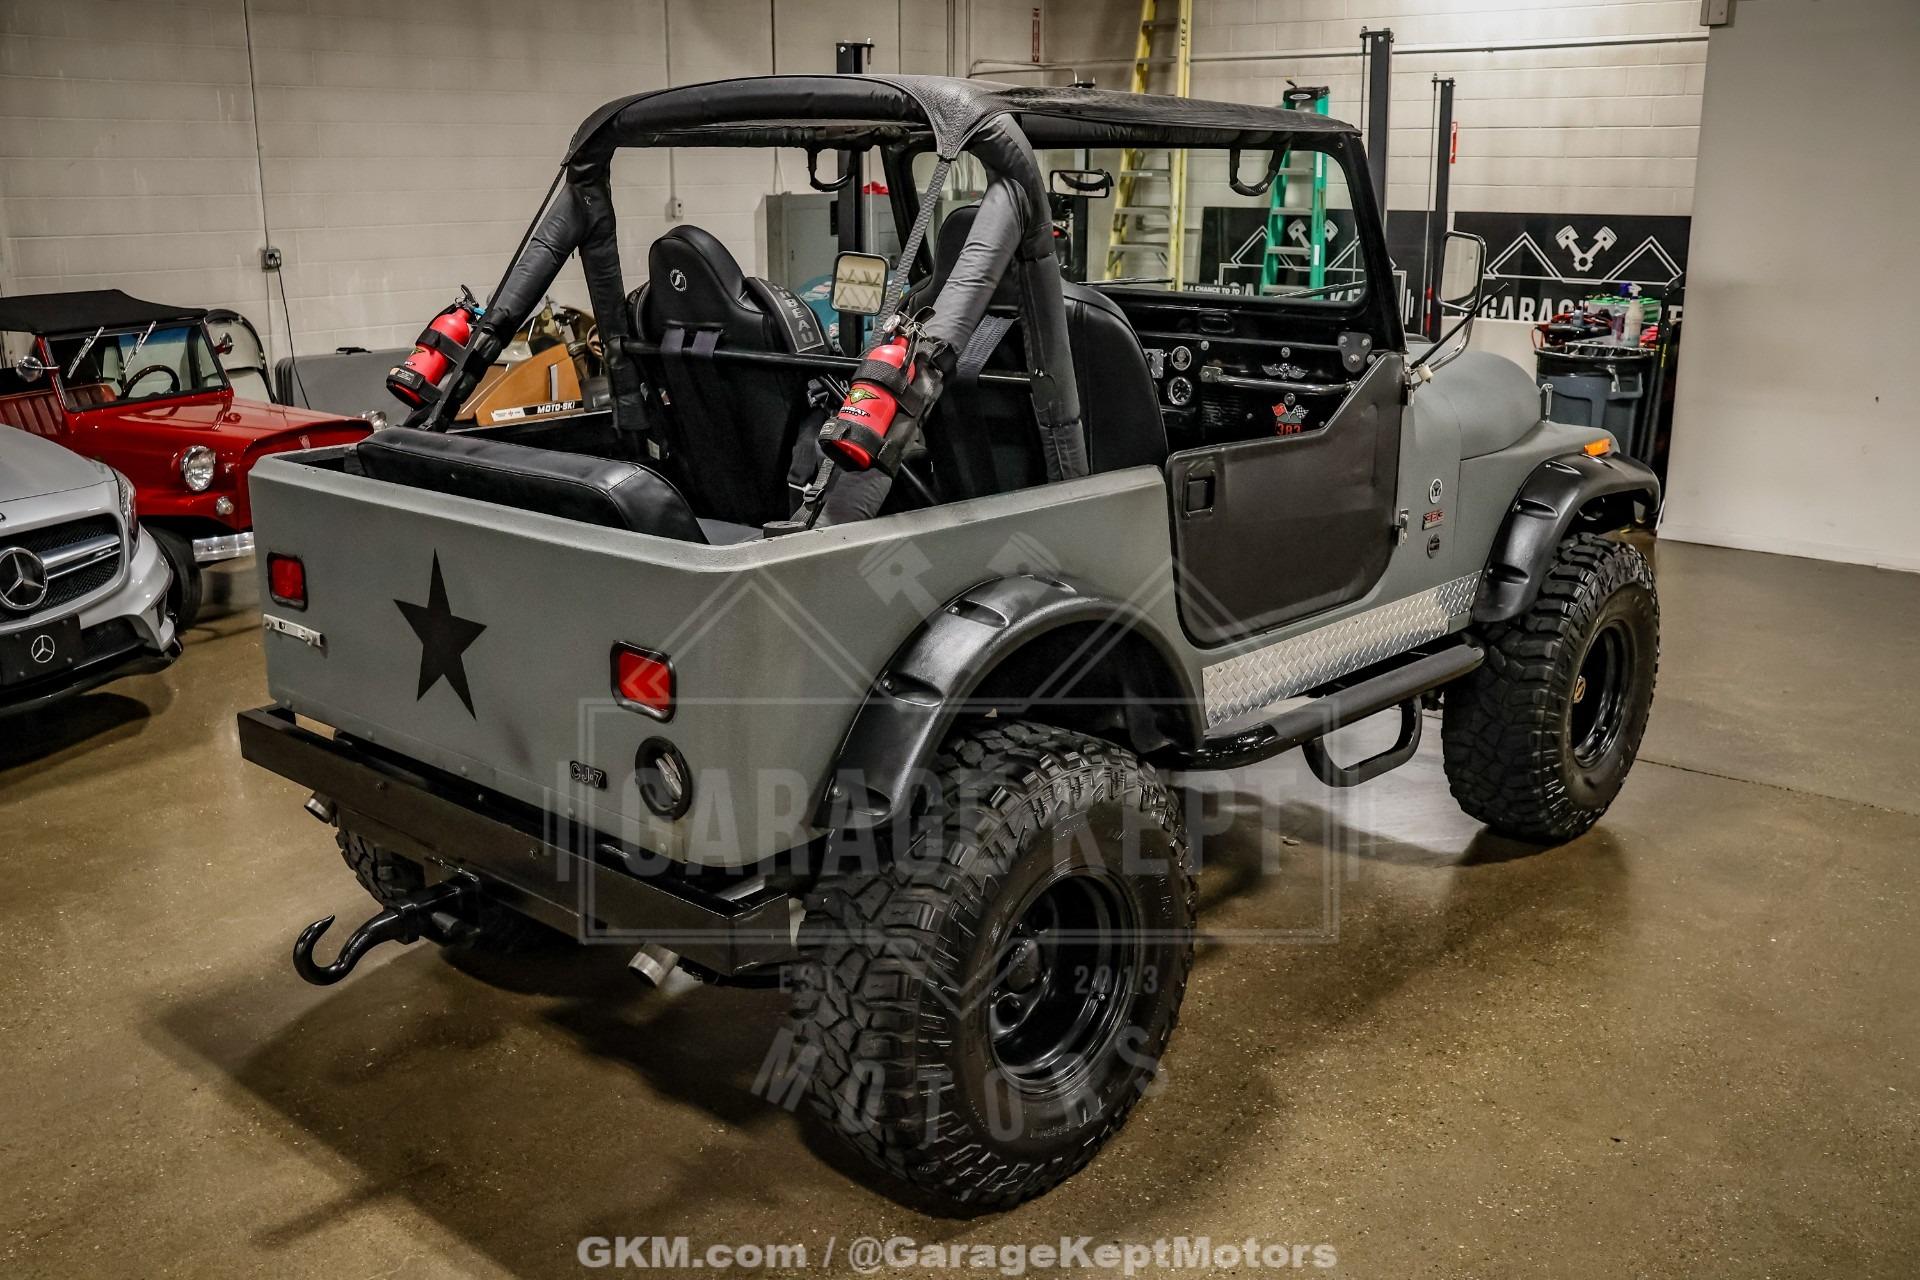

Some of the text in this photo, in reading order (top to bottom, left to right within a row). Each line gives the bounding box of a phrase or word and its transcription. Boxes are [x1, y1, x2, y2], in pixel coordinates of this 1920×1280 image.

[1195, 285, 1220, 294] CHANCE
[1221, 287, 1231, 295] TO
[570, 762, 603, 788] CJ-7
